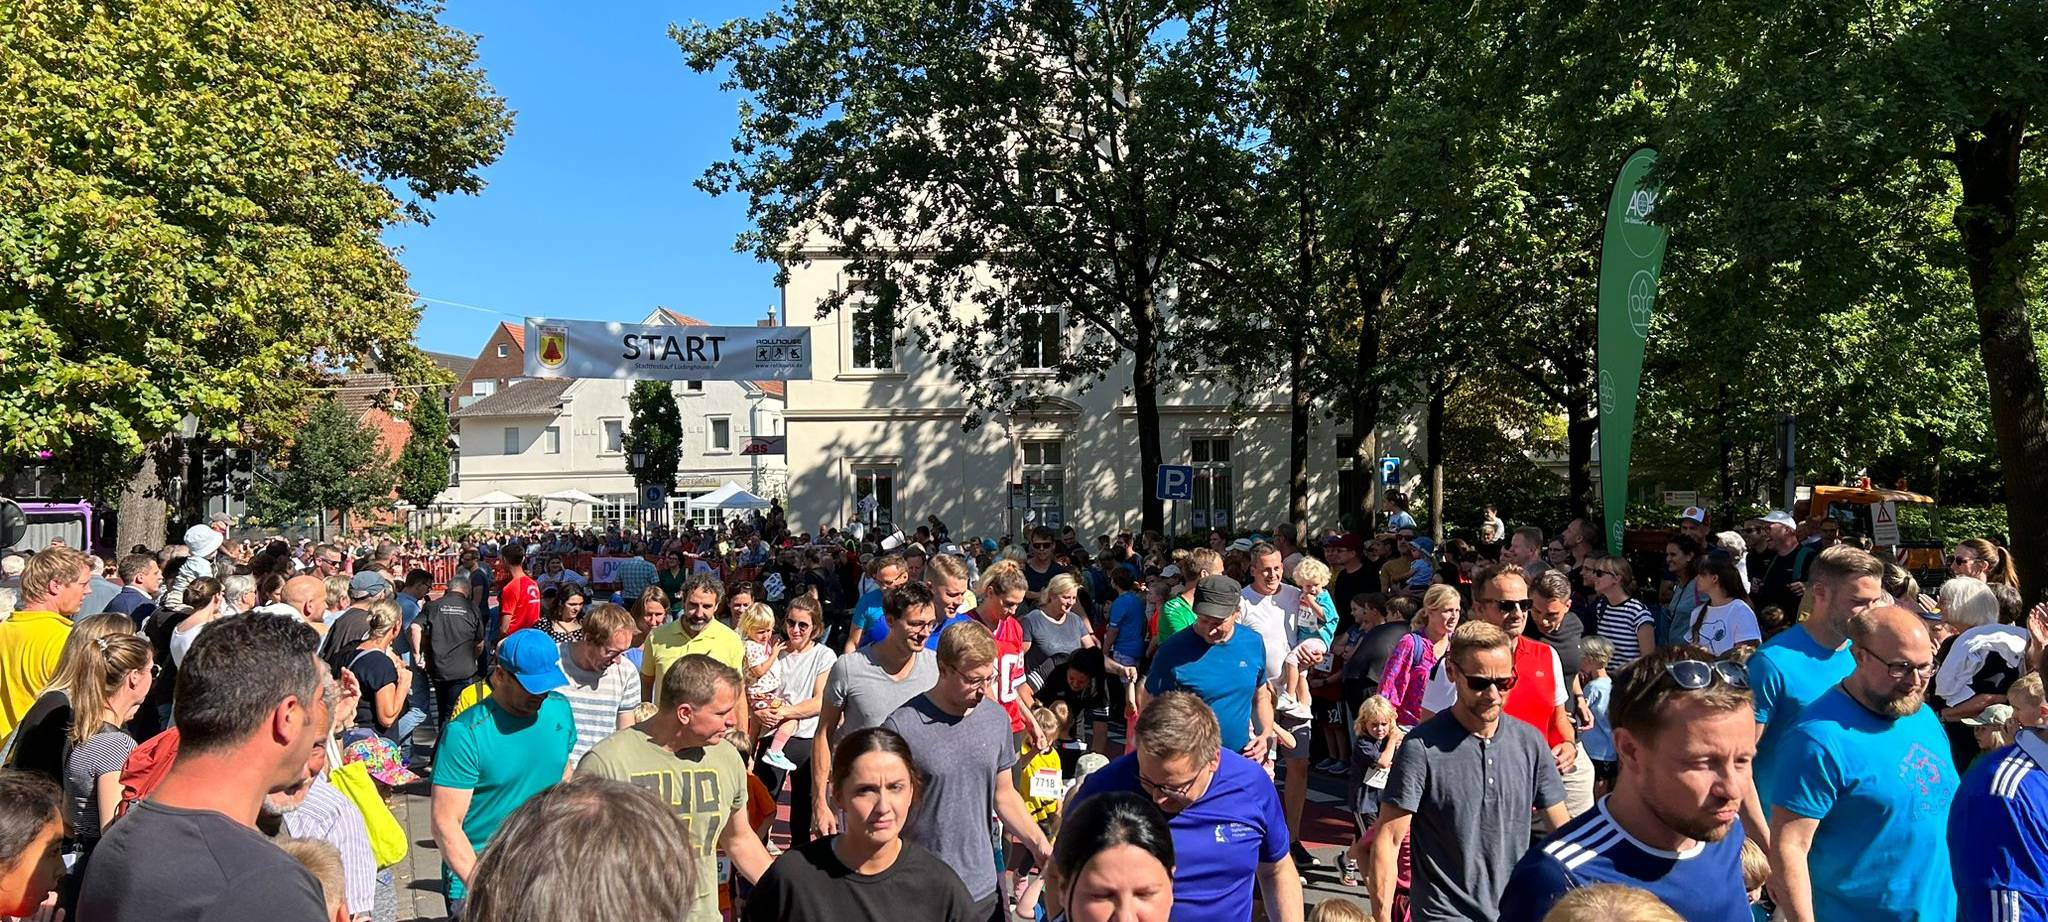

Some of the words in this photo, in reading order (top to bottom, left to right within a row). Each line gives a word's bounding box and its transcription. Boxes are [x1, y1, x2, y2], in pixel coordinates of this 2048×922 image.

[1625, 190, 1659, 217] AOK
[622, 334, 726, 361] START
[1165, 469, 1185, 495] P
[1383, 461, 1395, 481] P
[1035, 777, 1055, 788] 7718
